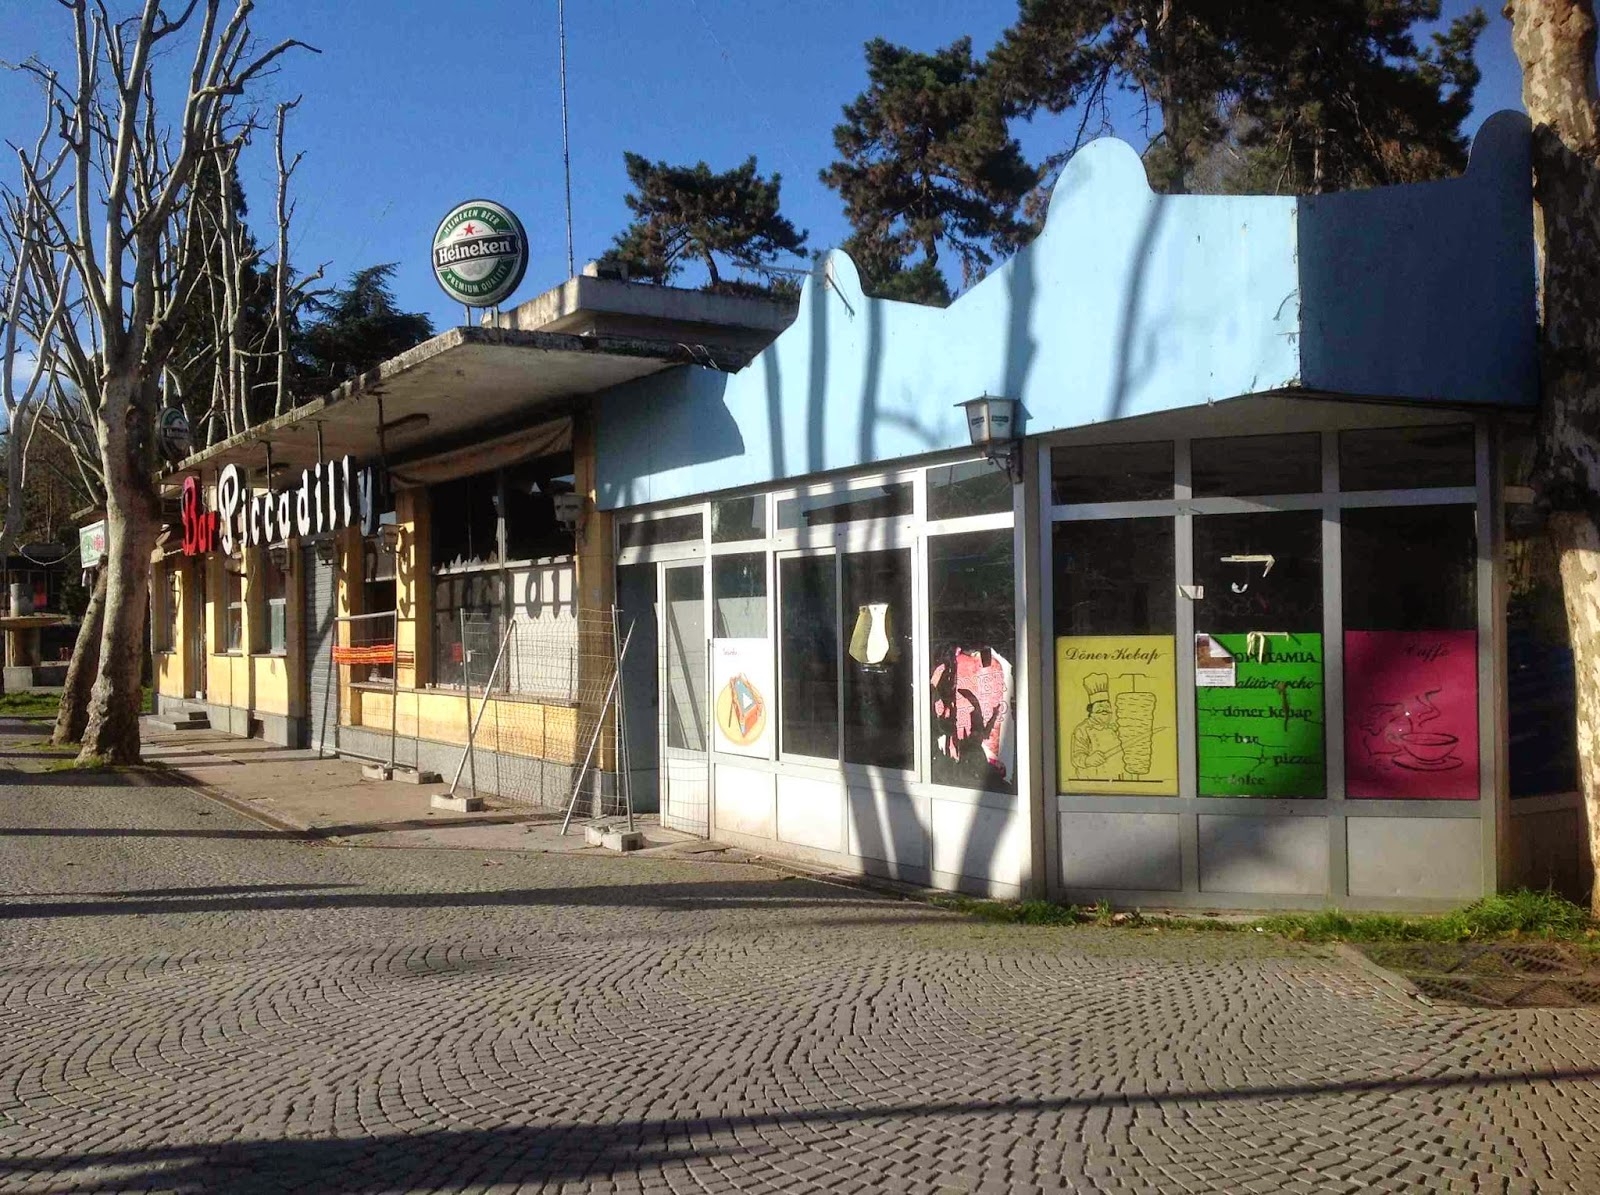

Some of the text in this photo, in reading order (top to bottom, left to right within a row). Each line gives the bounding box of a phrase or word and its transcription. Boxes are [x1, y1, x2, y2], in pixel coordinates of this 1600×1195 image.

[444, 209, 501, 234] HEINEKEN BEER
[438, 239, 511, 264] Heineken
[446, 264, 509, 293] PREMIUM QUALITY
[181, 454, 373, 556] Bar Piccadilly
[1111, 647, 1160, 665] Kebap
[1235, 733, 1259, 744] bar
